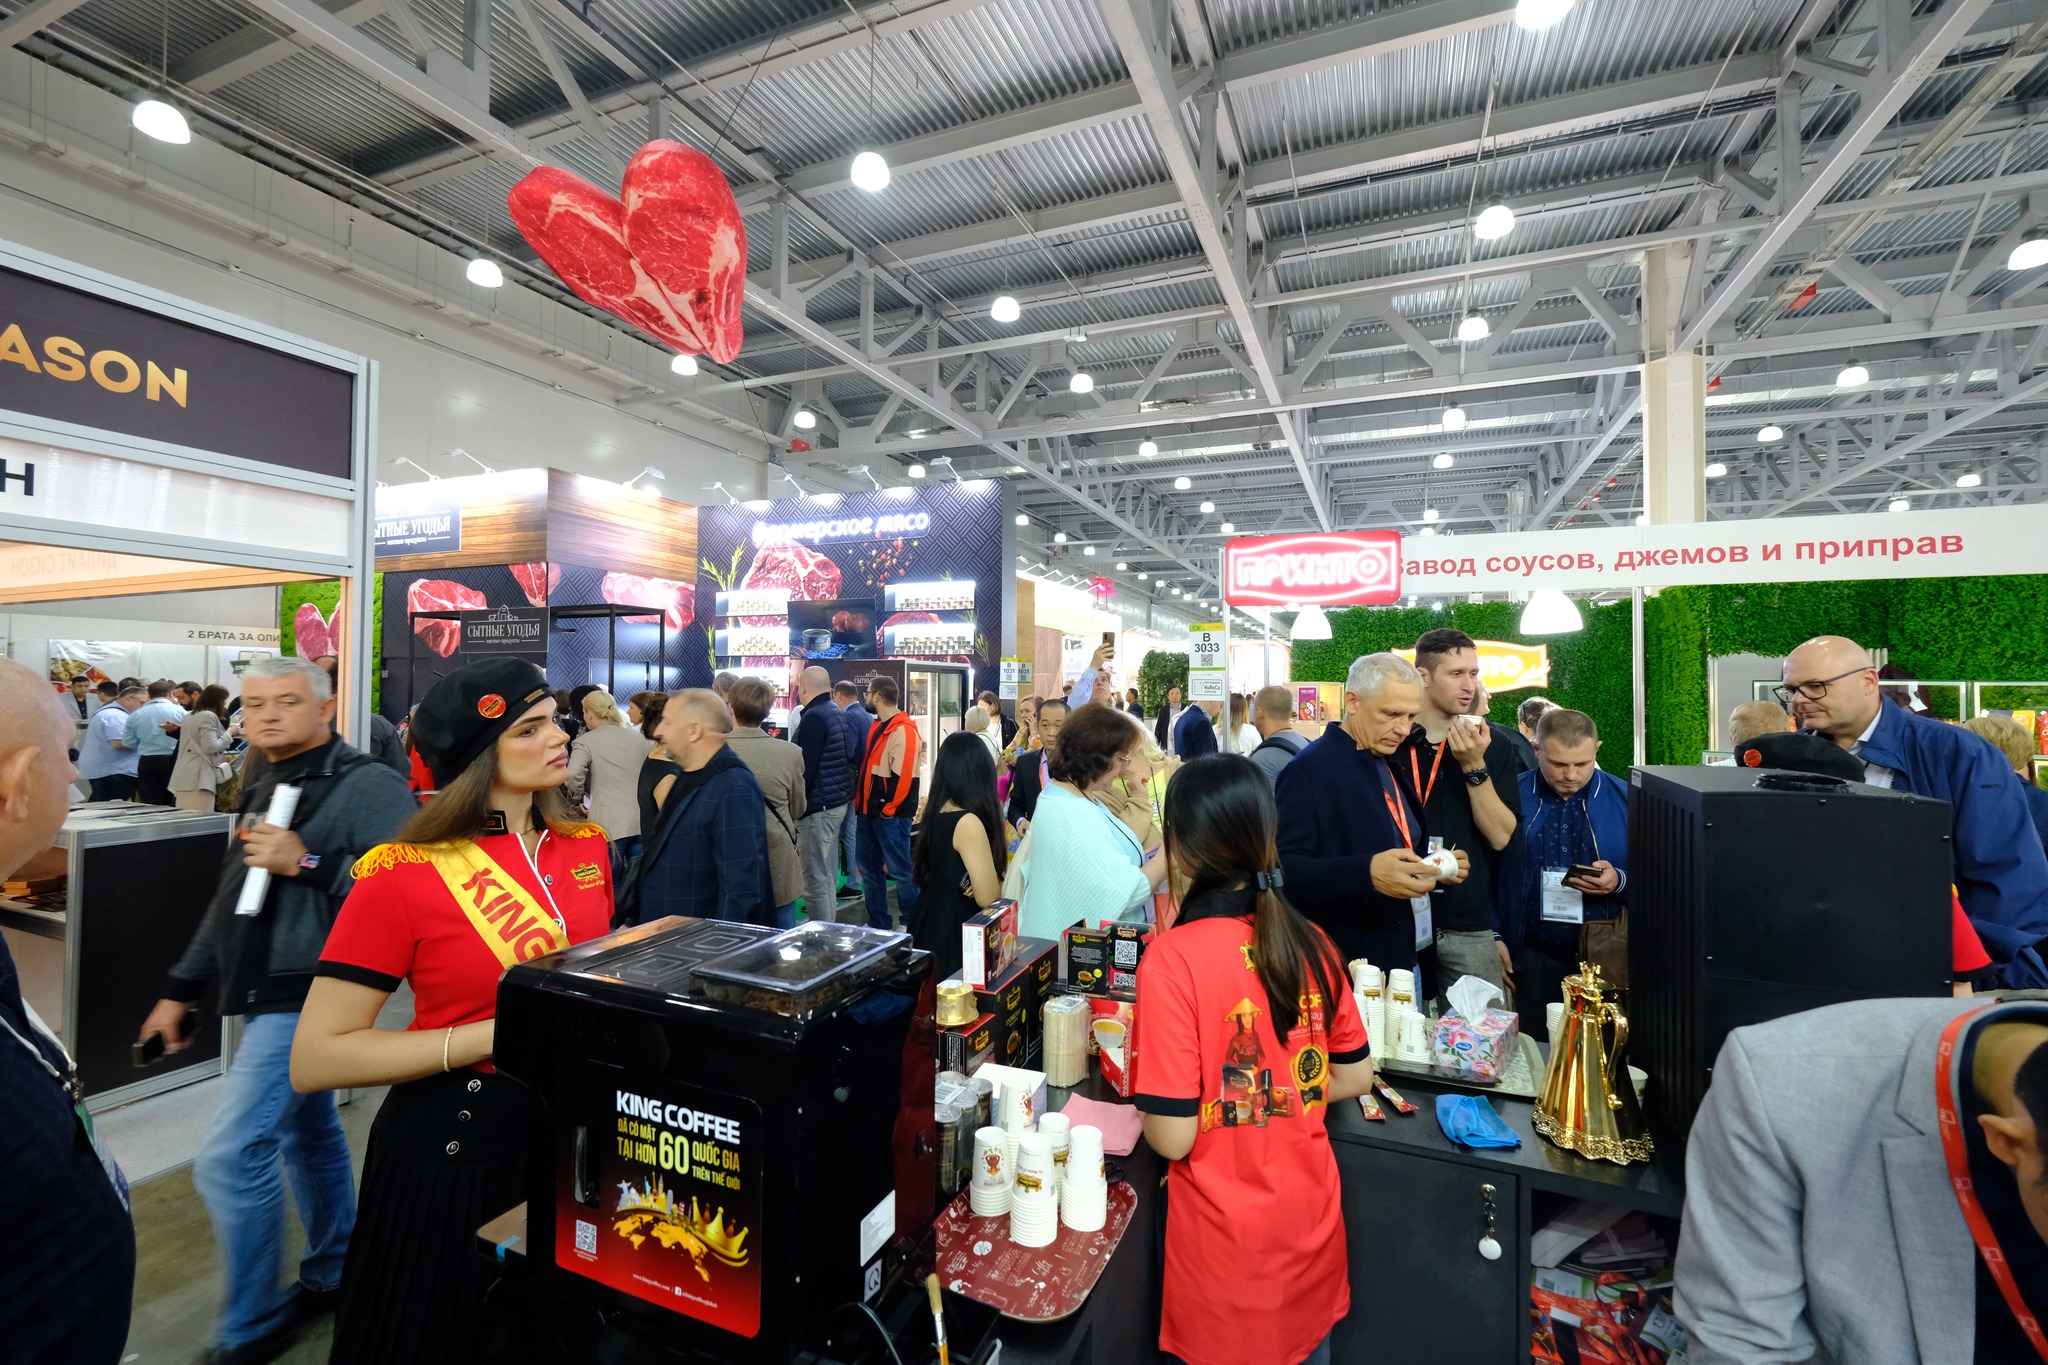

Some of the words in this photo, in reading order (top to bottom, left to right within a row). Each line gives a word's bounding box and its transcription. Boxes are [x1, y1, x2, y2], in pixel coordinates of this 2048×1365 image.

[0, 323, 188, 408] ASON
[411, 515, 451, 536] УГОДЬЯ
[1486, 553, 1604, 577] соусов,
[1614, 543, 1749, 571] джемов
[1762, 543, 1781, 561] и
[1796, 534, 1964, 564] приправ
[187, 630, 195, 639] 2
[198, 630, 236, 640] БРАТА
[239, 632, 254, 641] ЗА
[467, 624, 505, 638] СЫТНЫЕ
[507, 623, 540, 638] УГОДЬЯ
[1194, 642, 1220, 653] 3033
[461, 867, 558, 963] KING
[616, 1090, 663, 1123] KING
[664, 1104, 740, 1145] COFFEE
[628, 1120, 639, 1136] CÓ
[616, 1136, 633, 1161] TẠI
[635, 1141, 657, 1166] HƠN
[659, 1130, 690, 1175] 60
[692, 1140, 720, 1167] QUỐC
[722, 1149, 740, 1172] GIA
[691, 1165, 711, 1182] TRÊN
[711, 1170, 726, 1187] THẾ
